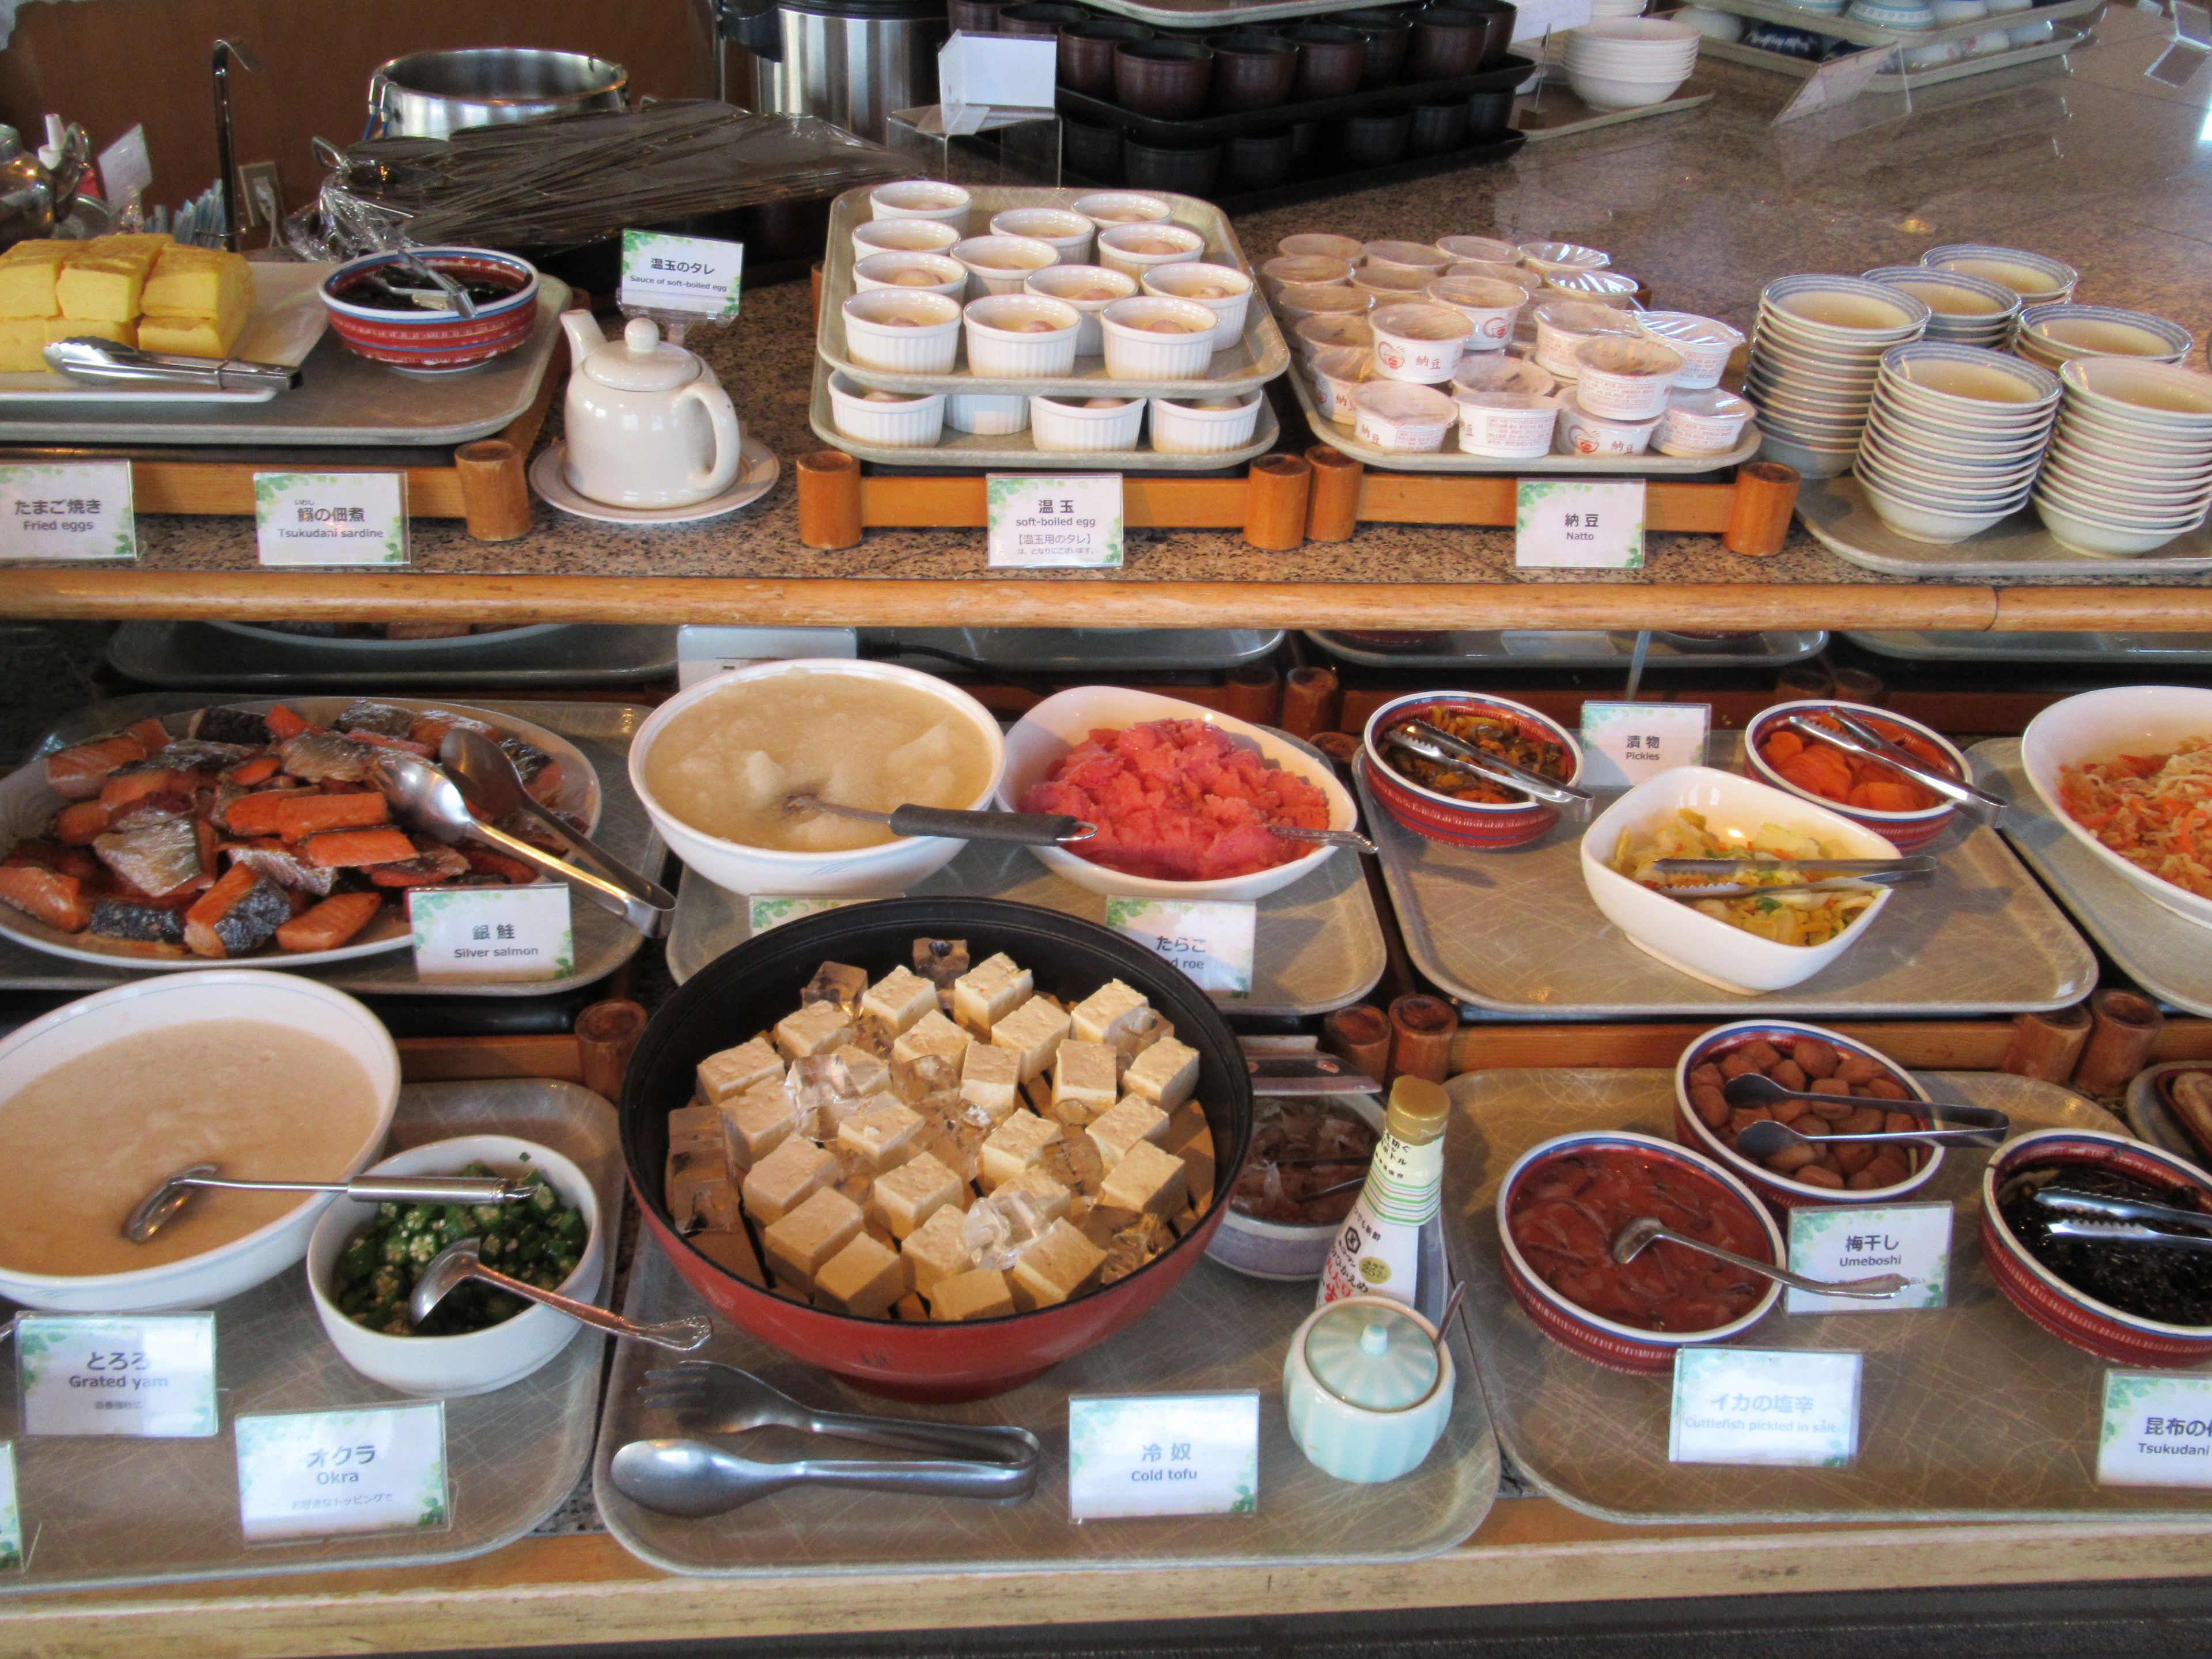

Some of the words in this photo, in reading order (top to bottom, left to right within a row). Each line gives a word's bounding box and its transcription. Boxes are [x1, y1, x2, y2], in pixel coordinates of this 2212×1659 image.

[650, 257, 715, 275] 温玉のタレ
[630, 275, 654, 284] Sauce
[667, 279, 710, 290] soft-boiled
[713, 284, 728, 293] egg
[14, 499, 102, 515] たまご焼き
[1039, 499, 1074, 514] 温玉
[24, 520, 58, 531] Fried
[62, 521, 94, 532] eggs
[1016, 517, 1073, 527] soft-boiled
[1076, 518, 1096, 528] egg
[1565, 513, 1599, 528] 納豆
[278, 528, 338, 538] Tsukudani
[341, 528, 384, 538] sardine
[1566, 532, 1594, 541] Natto
[1626, 751, 1660, 761] Pickles
[1156, 935, 1206, 953] たらこ
[454, 948, 490, 959] Silver
[493, 946, 539, 957] salmon
[1183, 960, 1204, 969] roe
[1845, 1234, 1900, 1252] 梅干し
[1839, 1255, 1902, 1267] Umeboshi
[87, 1351, 150, 1371] とろろ
[69, 1374, 126, 1388] Grated
[132, 1376, 169, 1390] yam
[1685, 1417, 1745, 1430] Cuttlefish
[1749, 1419, 1793, 1433] pickled
[1797, 1421, 1809, 1433] in
[1813, 1420, 1836, 1434] salt
[306, 1444, 376, 1468] オクラ
[2138, 1442, 2210, 1456] Tsukudani
[316, 1469, 359, 1485] Okra
[1131, 1469, 1162, 1482] Cold
[1168, 1468, 1198, 1480] tofu
